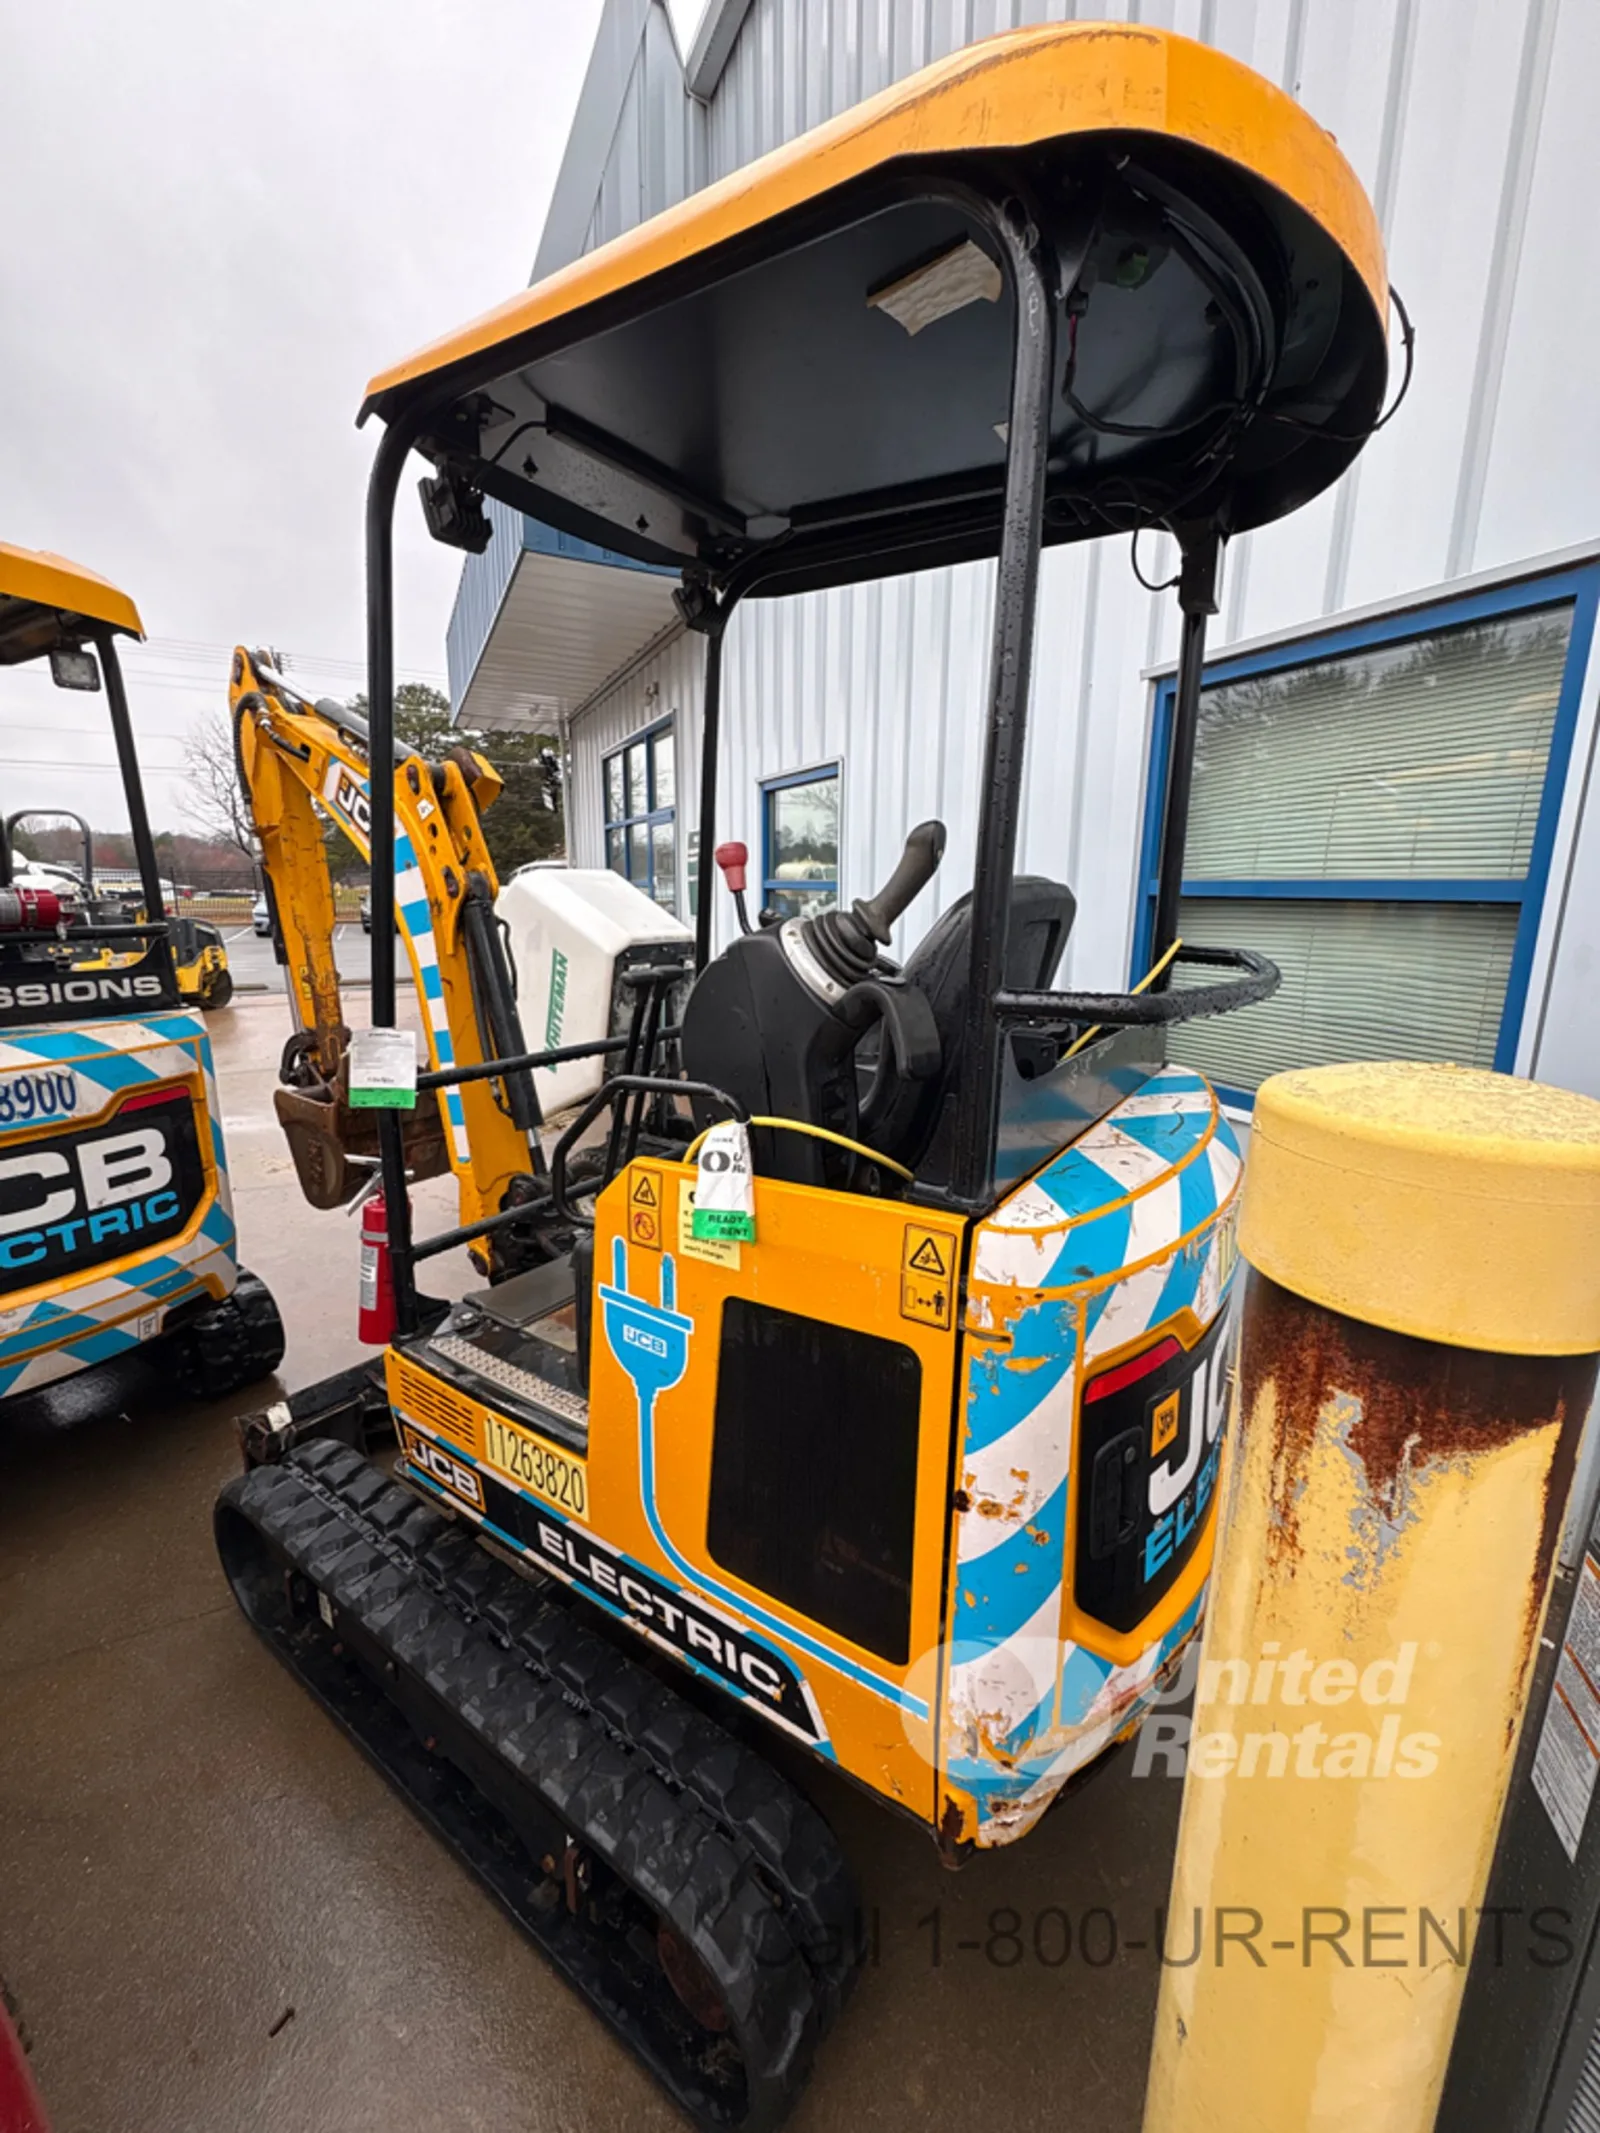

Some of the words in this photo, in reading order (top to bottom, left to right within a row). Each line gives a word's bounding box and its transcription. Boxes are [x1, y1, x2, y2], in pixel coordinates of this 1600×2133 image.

[338, 786, 371, 832] JC
[0, 1191, 180, 1269] CTRIC
[708, 1214, 744, 1224] READY
[720, 1227, 748, 1236] RENT
[626, 1327, 664, 1354] JCB
[1148, 1315, 1230, 1516] JC
[411, 1438, 480, 1502] JCB
[486, 1417, 584, 1515] 11263820
[538, 1521, 782, 1696] ELECTRIC
